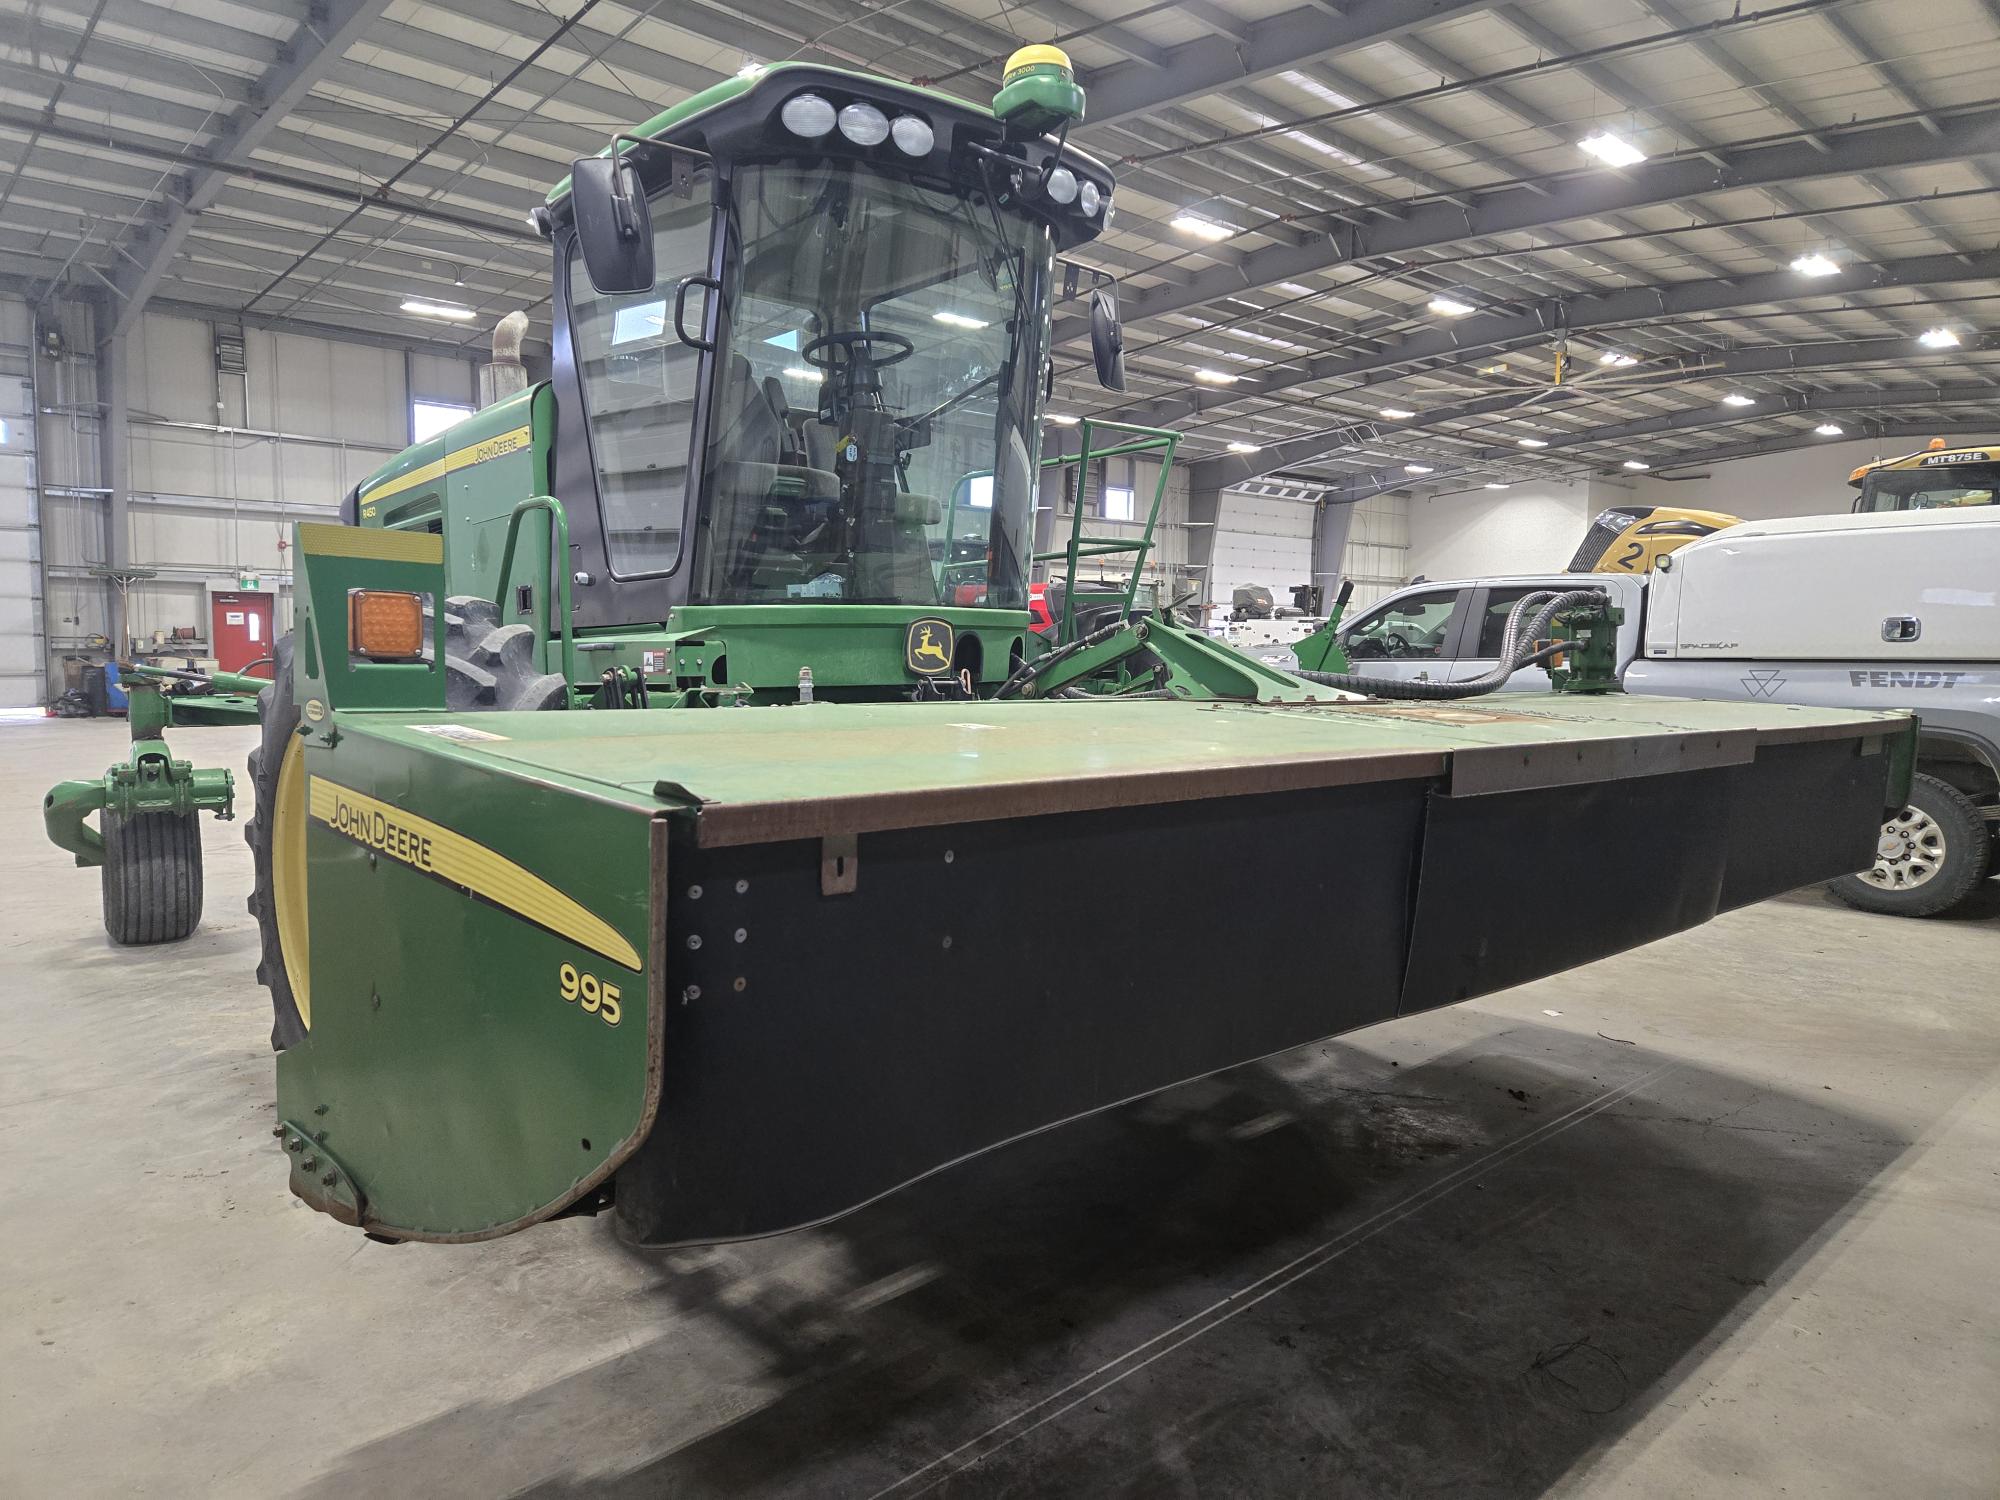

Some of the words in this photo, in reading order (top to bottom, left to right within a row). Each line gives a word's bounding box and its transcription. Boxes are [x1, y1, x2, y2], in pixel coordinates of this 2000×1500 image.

[474, 444, 493, 462] JOHN
[493, 437, 518, 455] DEERE
[1927, 452, 1983, 465] MT875E
[1617, 542, 1644, 571] 2
[1848, 670, 1966, 689] FENDT
[330, 794, 371, 841] JOHN
[373, 811, 432, 868] DEERE
[559, 961, 622, 1027] 995
